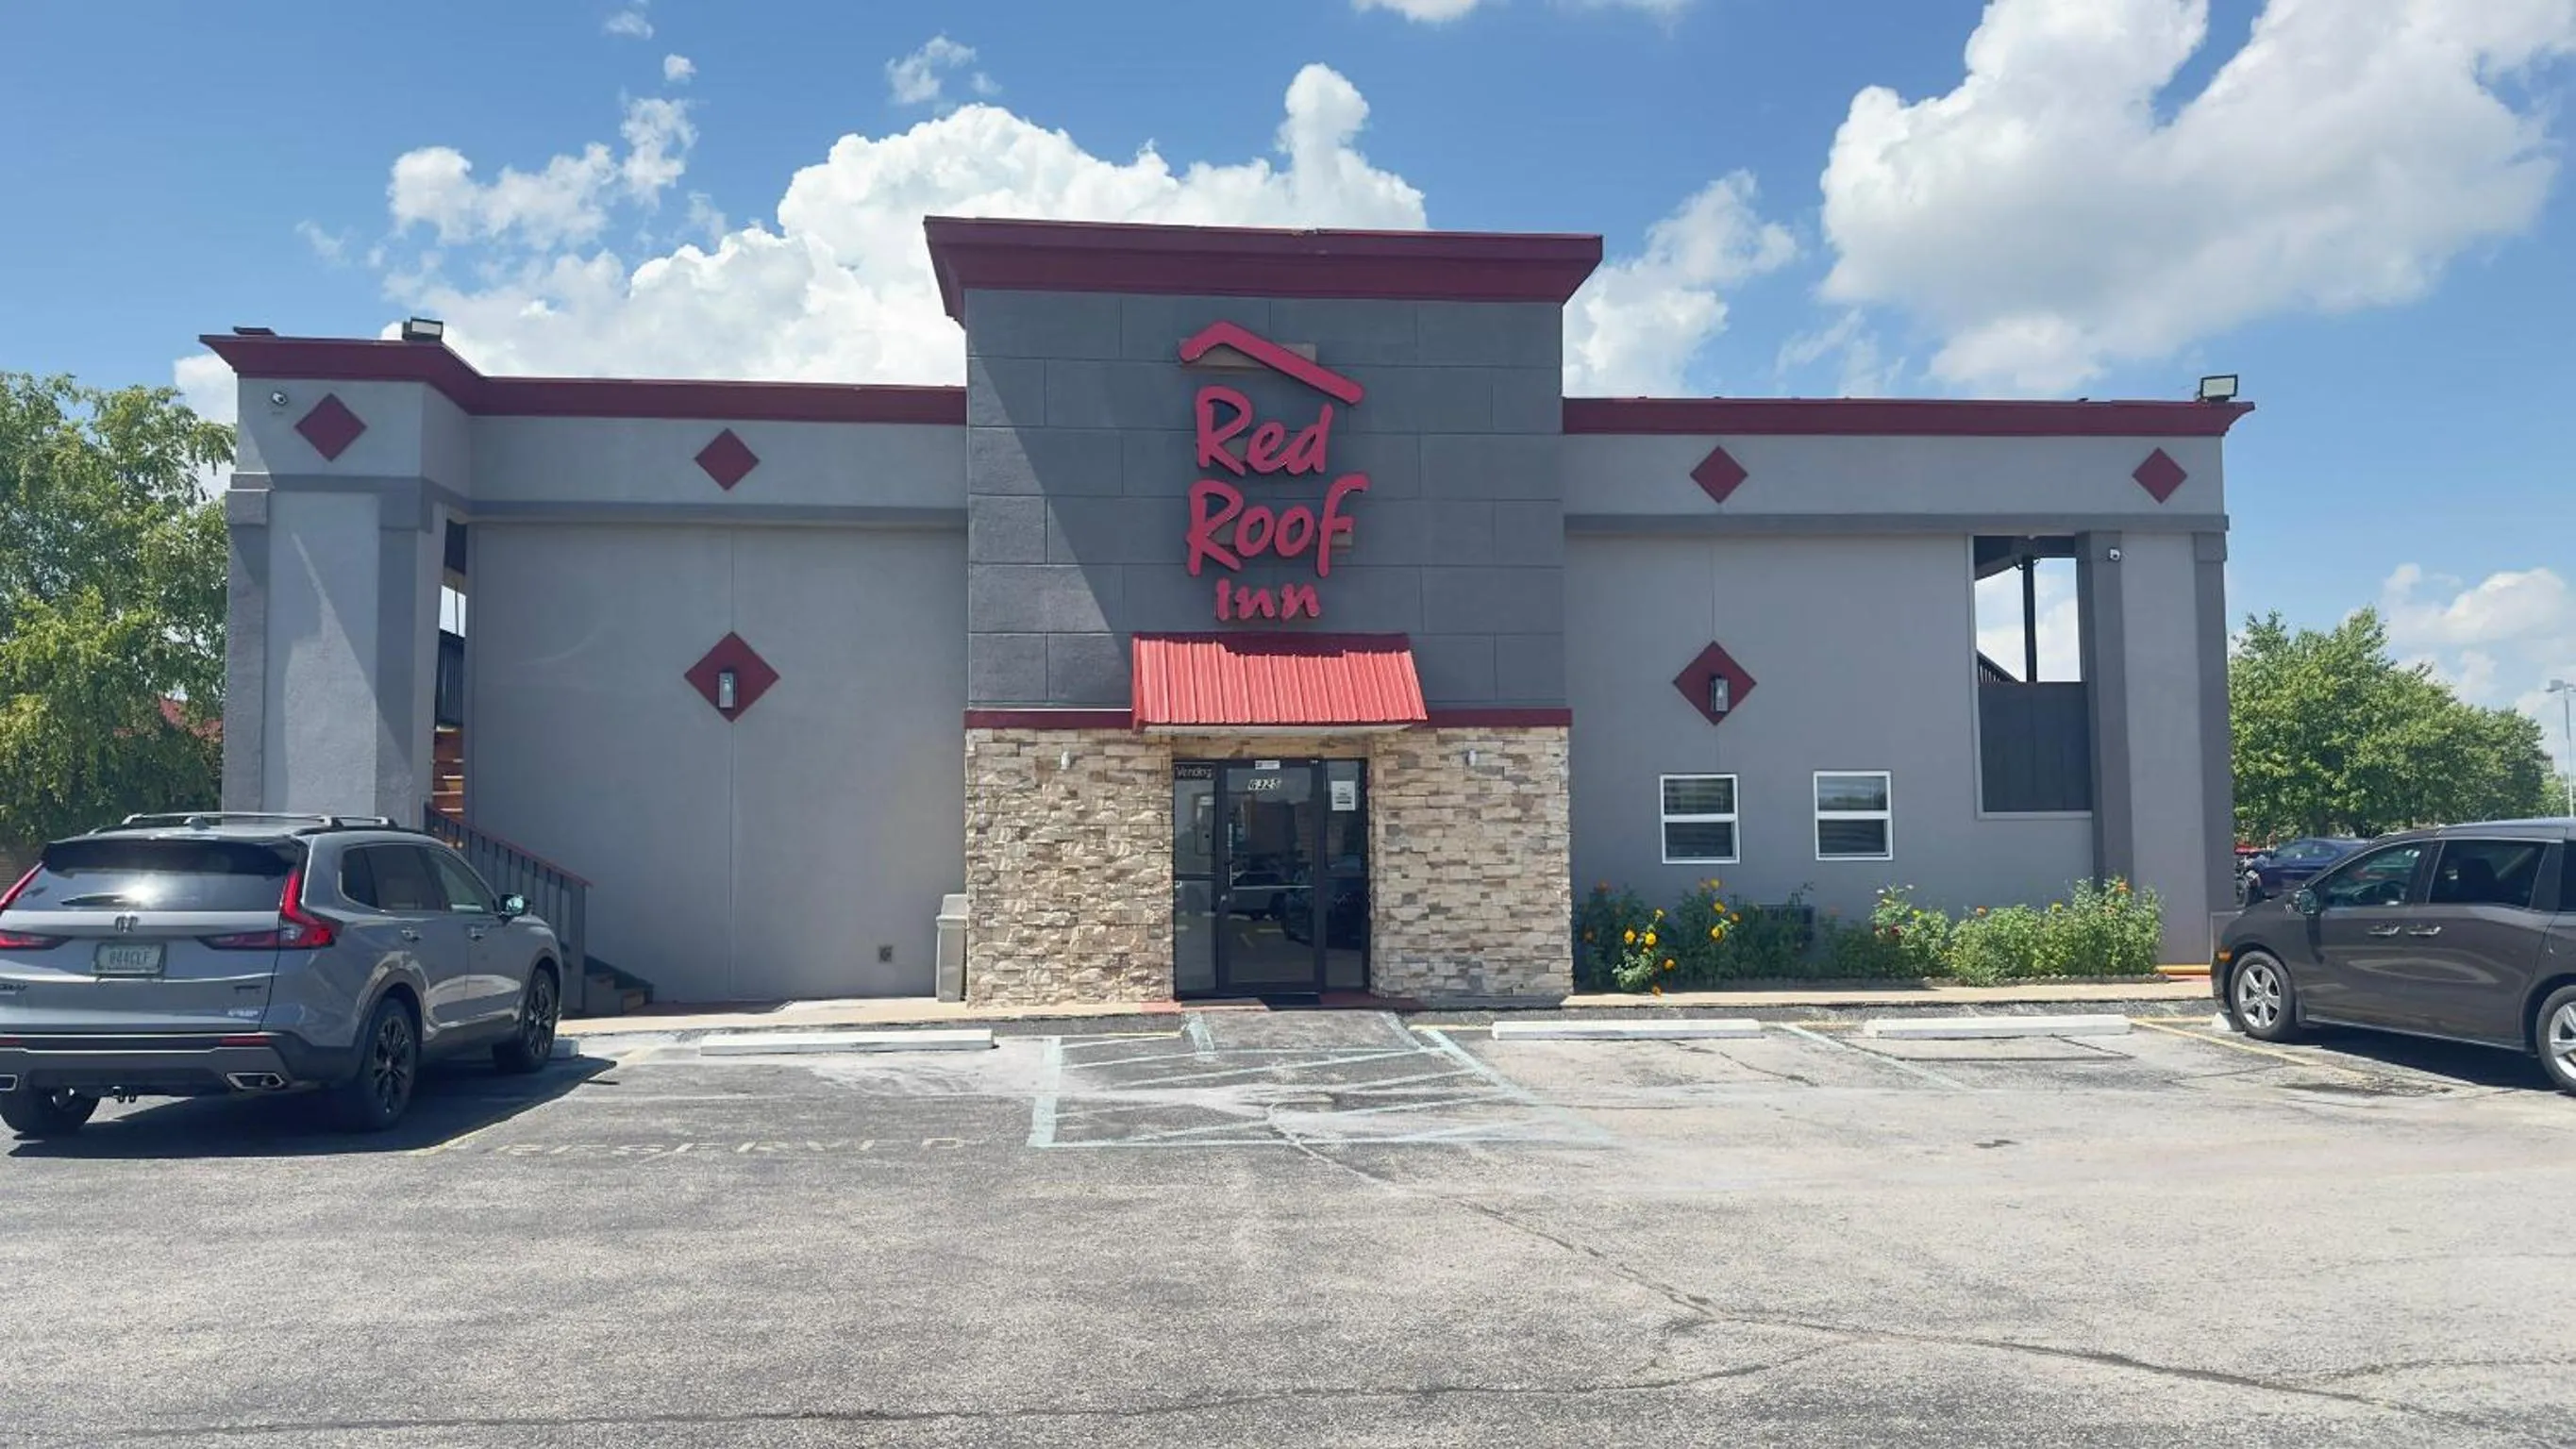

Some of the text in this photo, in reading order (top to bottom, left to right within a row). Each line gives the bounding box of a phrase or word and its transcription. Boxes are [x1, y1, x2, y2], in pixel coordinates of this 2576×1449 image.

[1195, 385, 1333, 475] Red
[1186, 473, 1369, 576] Roof
[1215, 577, 1321, 621] Inn
